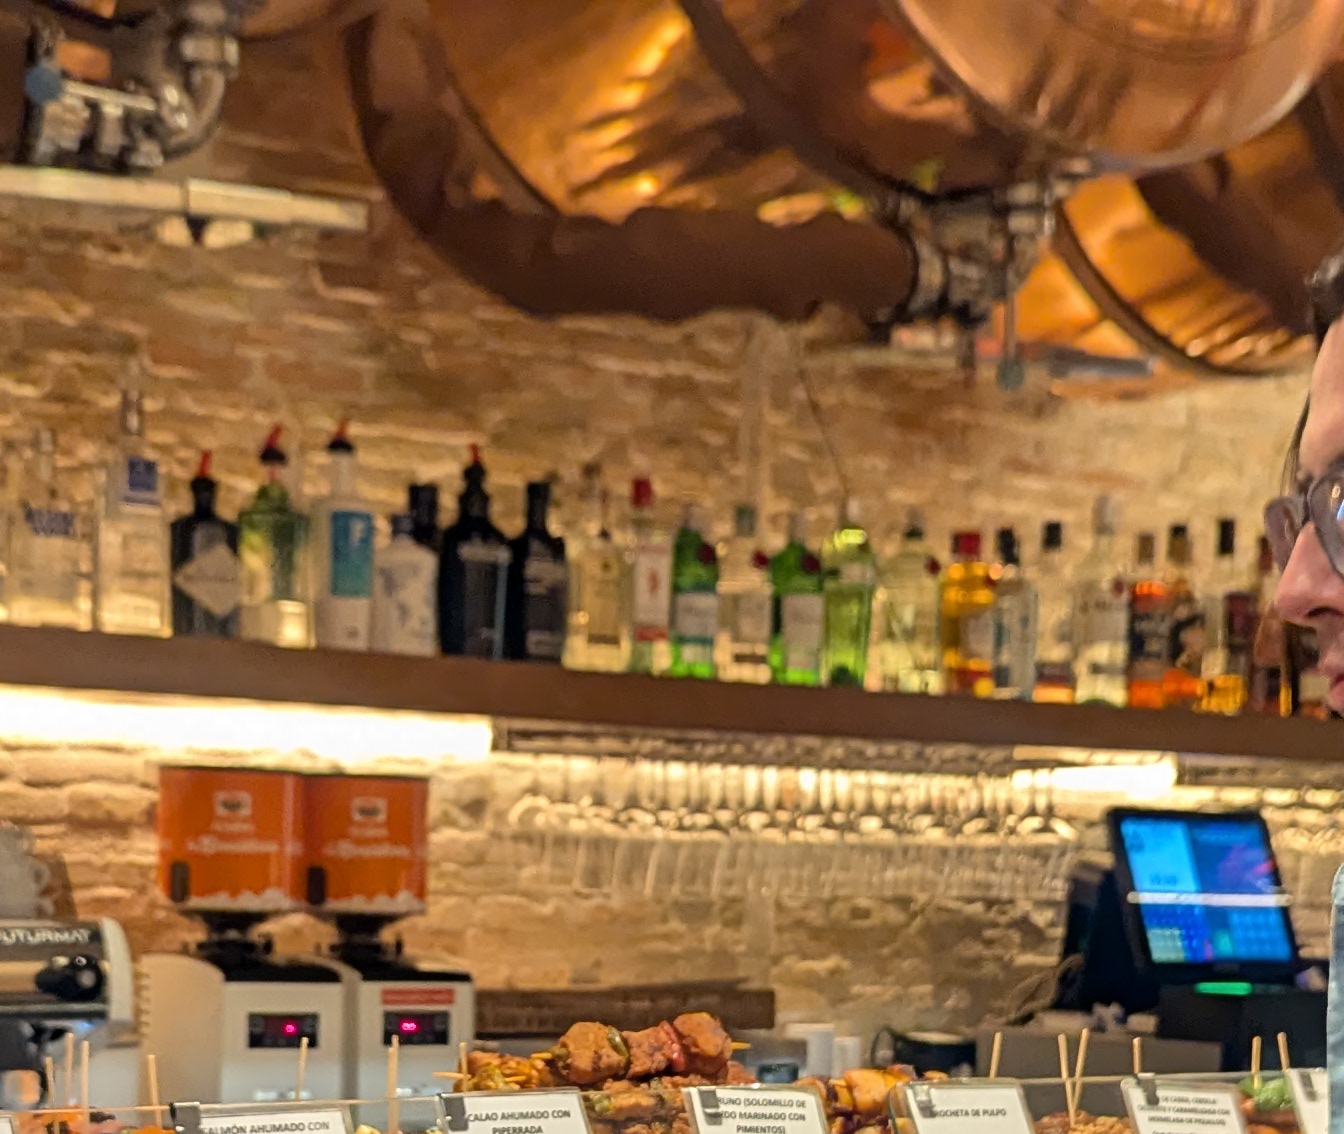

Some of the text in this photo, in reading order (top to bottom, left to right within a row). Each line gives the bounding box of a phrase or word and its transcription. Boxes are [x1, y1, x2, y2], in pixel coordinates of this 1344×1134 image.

[467, 1112, 498, 1122] CALAO
[250, 1123, 305, 1133] AHUMADO
[308, 1121, 329, 1131] CON
